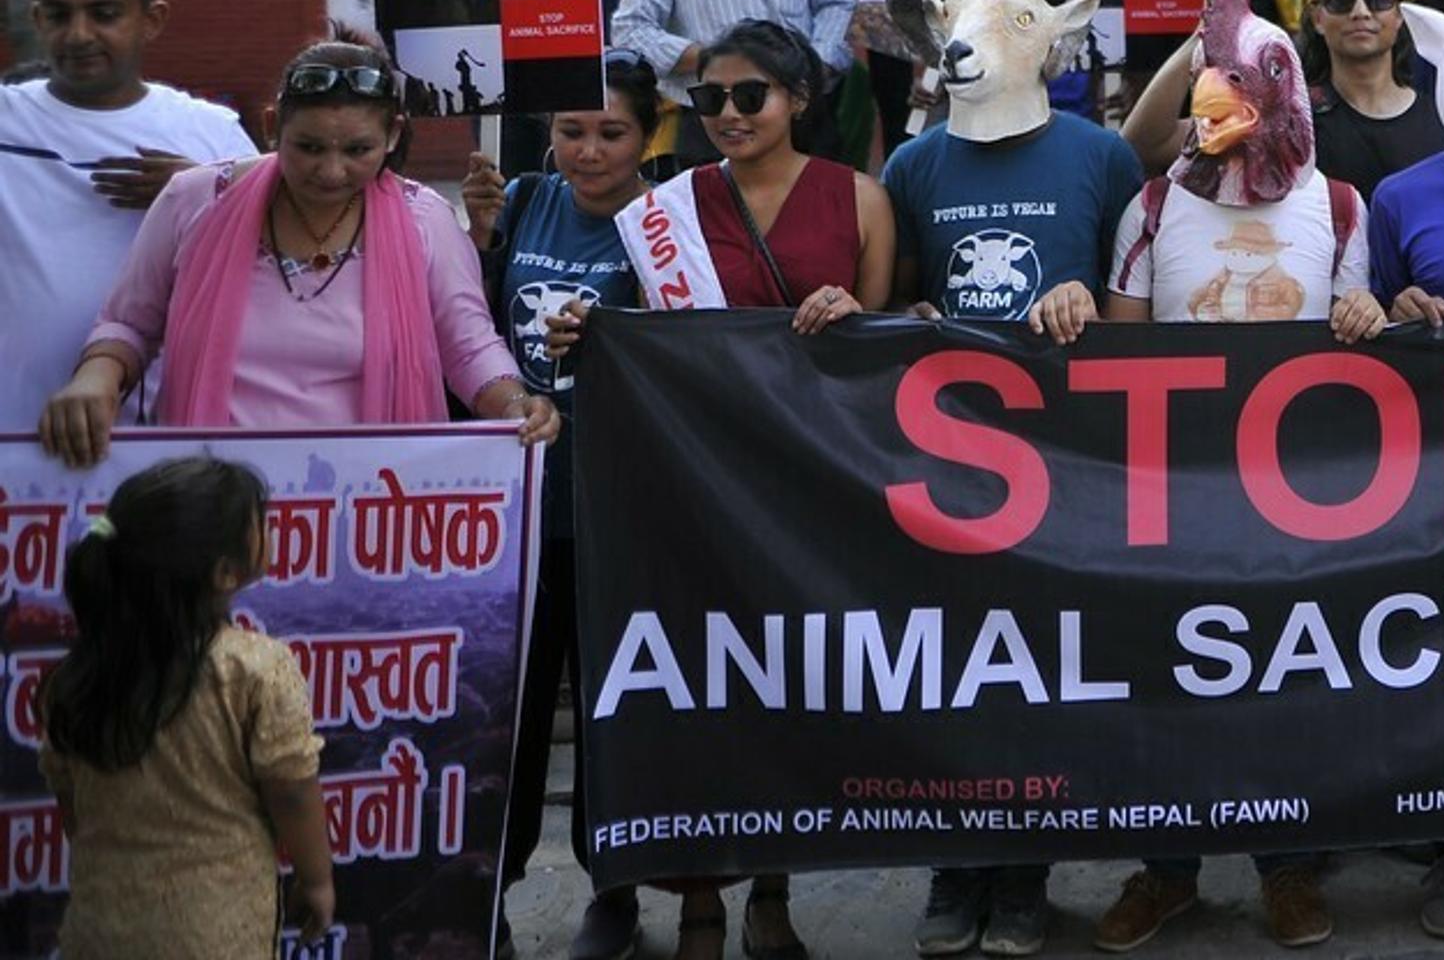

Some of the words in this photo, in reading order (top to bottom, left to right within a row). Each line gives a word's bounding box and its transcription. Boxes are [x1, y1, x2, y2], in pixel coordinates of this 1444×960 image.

[539, 12, 565, 24] STOP
[508, 26, 545, 37] ANIMAL
[545, 23, 596, 36] SACRIFICE
[933, 204, 988, 224] FUTURE
[990, 203, 1008, 218] IS
[1012, 202, 1057, 216] VEGAN
[642, 191, 678, 271] SS
[567, 261, 588, 273] IS
[958, 290, 1013, 309] FARM
[524, 342, 550, 361] FA
[353, 467, 505, 574] पोषक
[592, 607, 1130, 720] ANIMAL
[842, 777, 1015, 802] ORGANISED
[1025, 776, 1070, 800] BY:
[594, 810, 784, 853] FEDERATION
[793, 808, 833, 833] OF
[840, 808, 953, 831] ANIMAL
[960, 807, 1099, 830] WELFARE
[1108, 803, 1202, 829] NEPAL
[1210, 797, 1310, 829] (FAWN)
